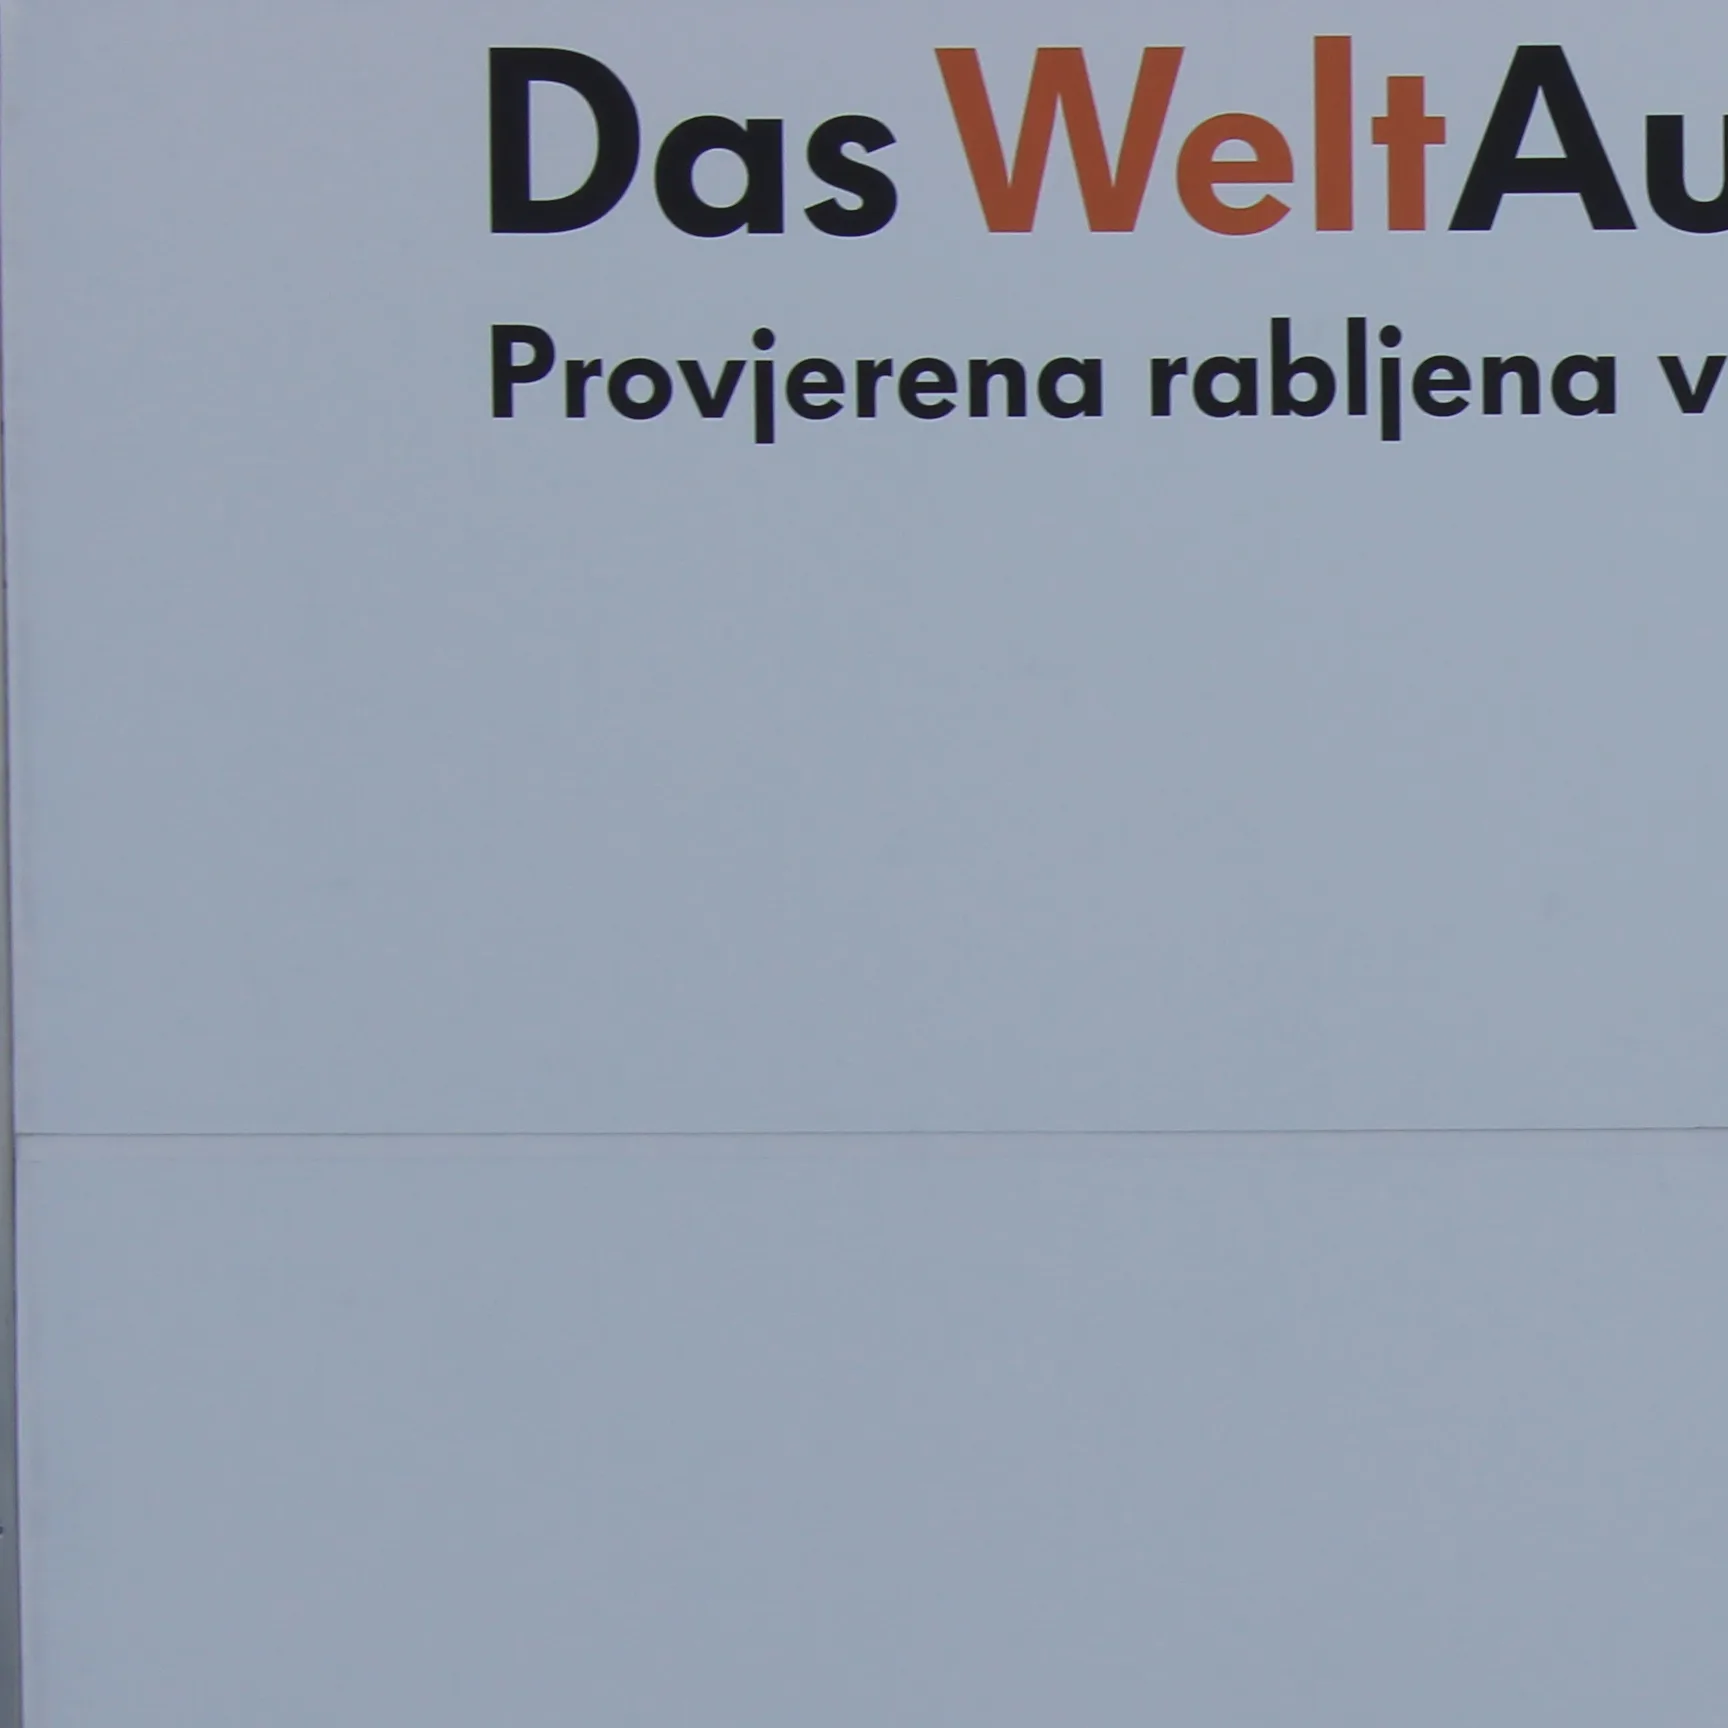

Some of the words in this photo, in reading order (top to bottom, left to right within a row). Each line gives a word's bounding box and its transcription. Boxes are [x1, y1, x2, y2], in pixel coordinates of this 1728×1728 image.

[489, 47, 898, 238] Das
[490, 324, 1103, 446] Provjerena
[1150, 316, 1617, 443] rabljena
